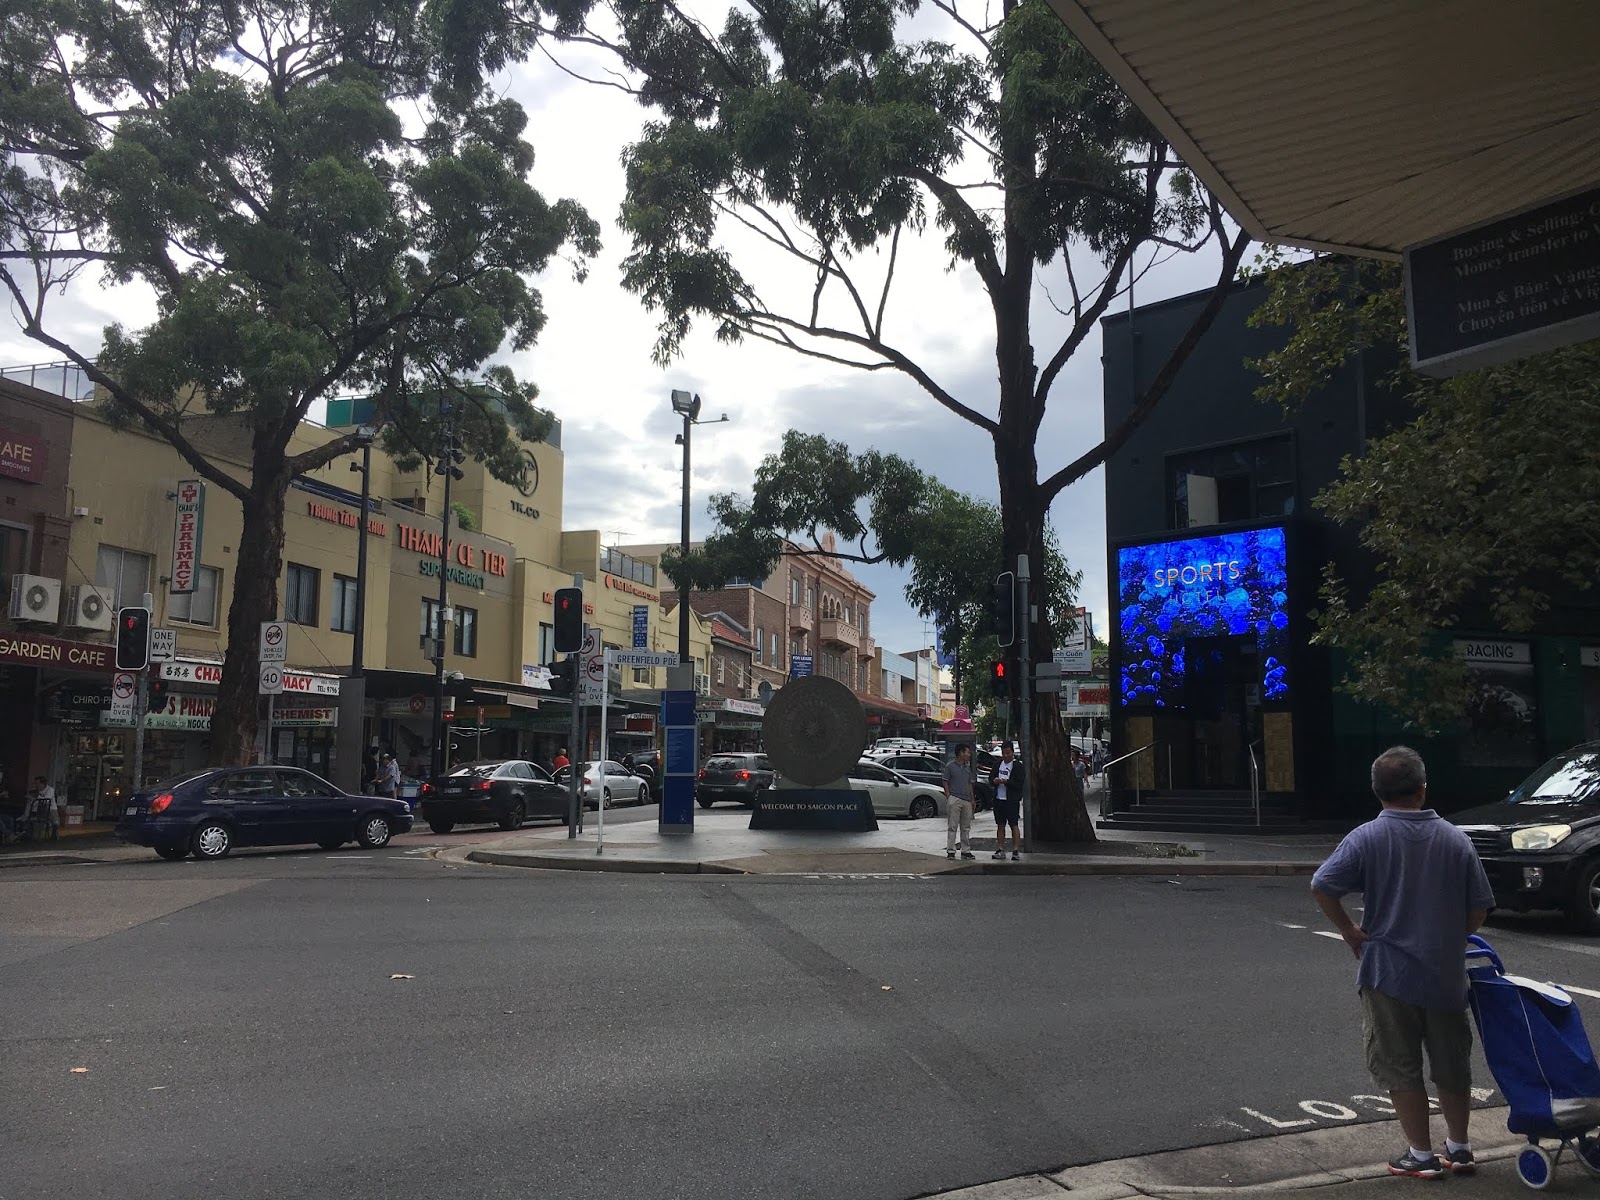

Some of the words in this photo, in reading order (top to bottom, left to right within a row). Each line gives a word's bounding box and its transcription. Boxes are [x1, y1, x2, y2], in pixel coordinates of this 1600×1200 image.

[1453, 236, 1505, 261] Buying
[1508, 229, 1521, 243] &
[1455, 258, 1502, 277] Money
[1508, 236, 1568, 262] transfer
[1572, 230, 1589, 243] to
[1496, 290, 1508, 304] &
[0, 440, 33, 463] AFE
[178, 503, 199, 512] CHAU'S
[308, 501, 338, 524] TRUNG
[509, 499, 540, 520] TK.CO
[175, 513, 194, 590] PHARMACY
[1154, 560, 1240, 589] SPORTS
[154, 631, 173, 640] ONE
[0, 638, 62, 661] GARDEN
[68, 648, 106, 667] CAFE
[152, 641, 174, 651] WAY
[1467, 644, 1514, 658] RACING
[617, 655, 660, 665] GREENFIELD
[662, 657, 678, 666] PDE
[263, 672, 278, 684] 40
[272, 709, 333, 720] CHEMIST
